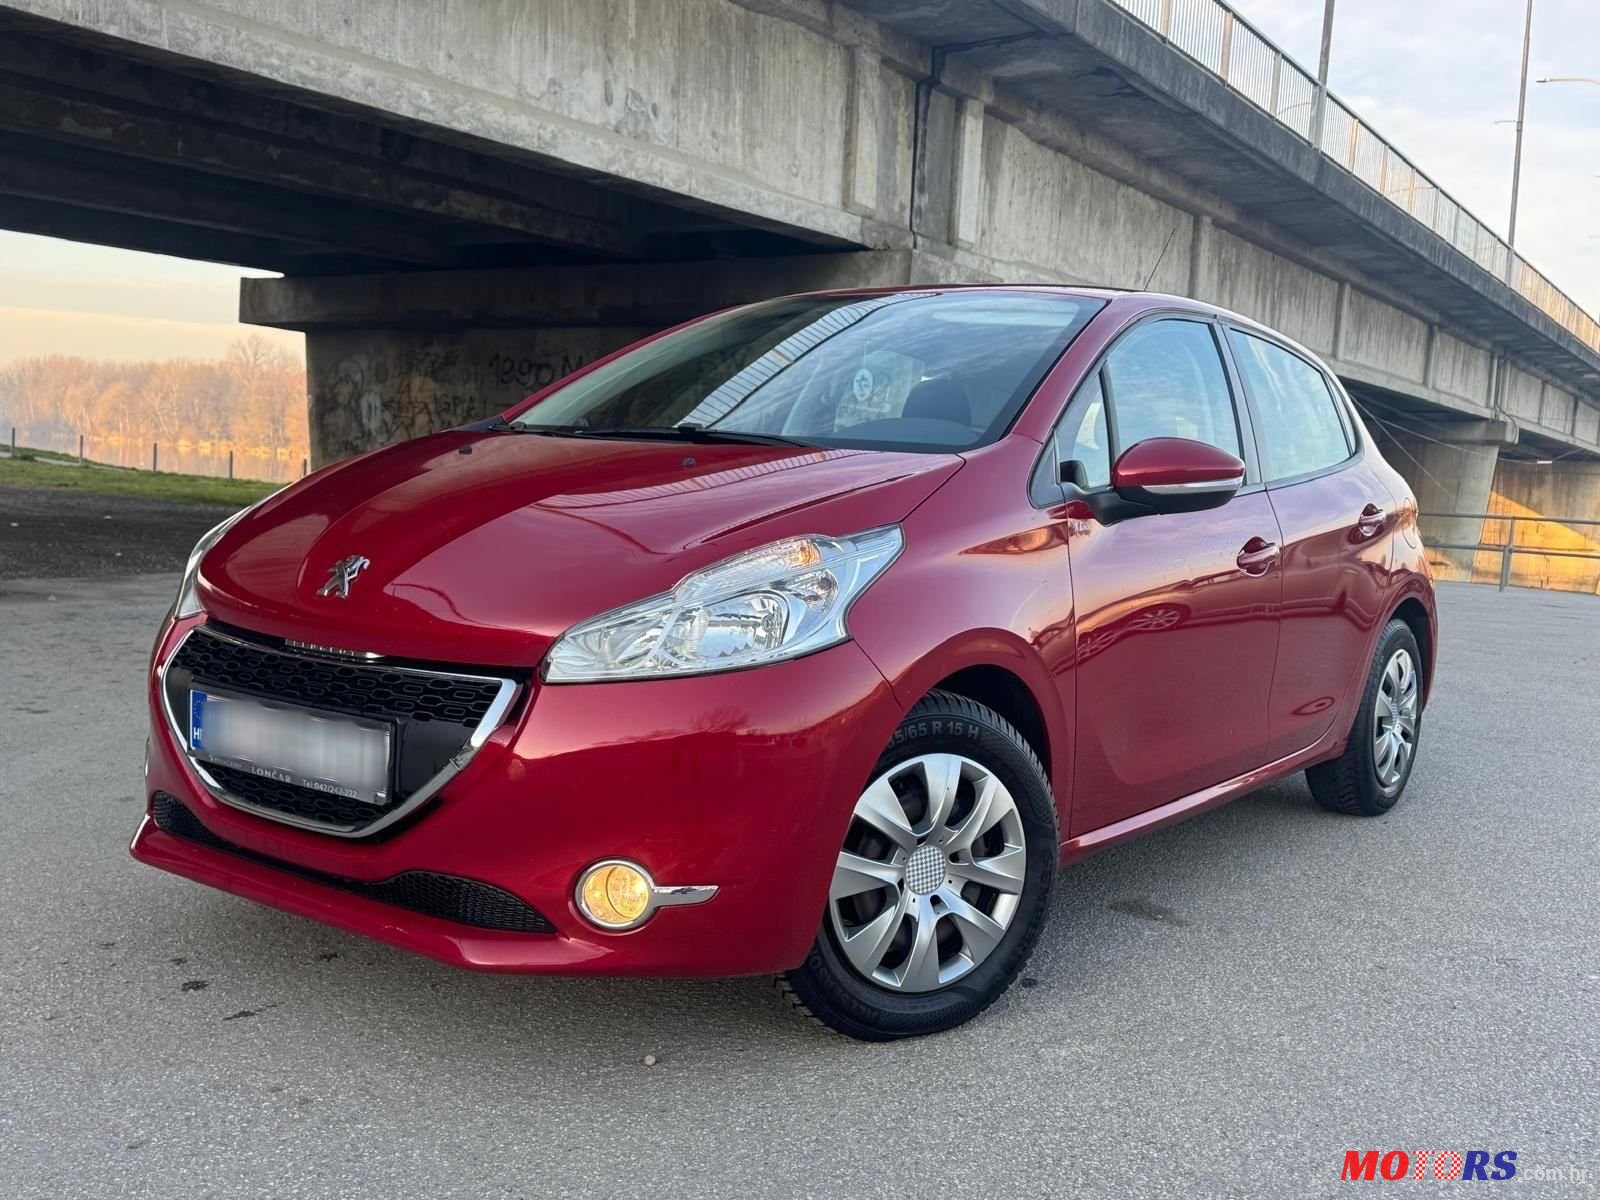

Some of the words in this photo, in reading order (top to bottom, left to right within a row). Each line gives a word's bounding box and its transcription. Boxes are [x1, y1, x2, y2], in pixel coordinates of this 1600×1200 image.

[193, 727, 204, 740] H
[931, 721, 942, 735] R
[946, 721, 963, 735] 15
[967, 725, 979, 740] H
[251, 766, 292, 783] LONČAR
